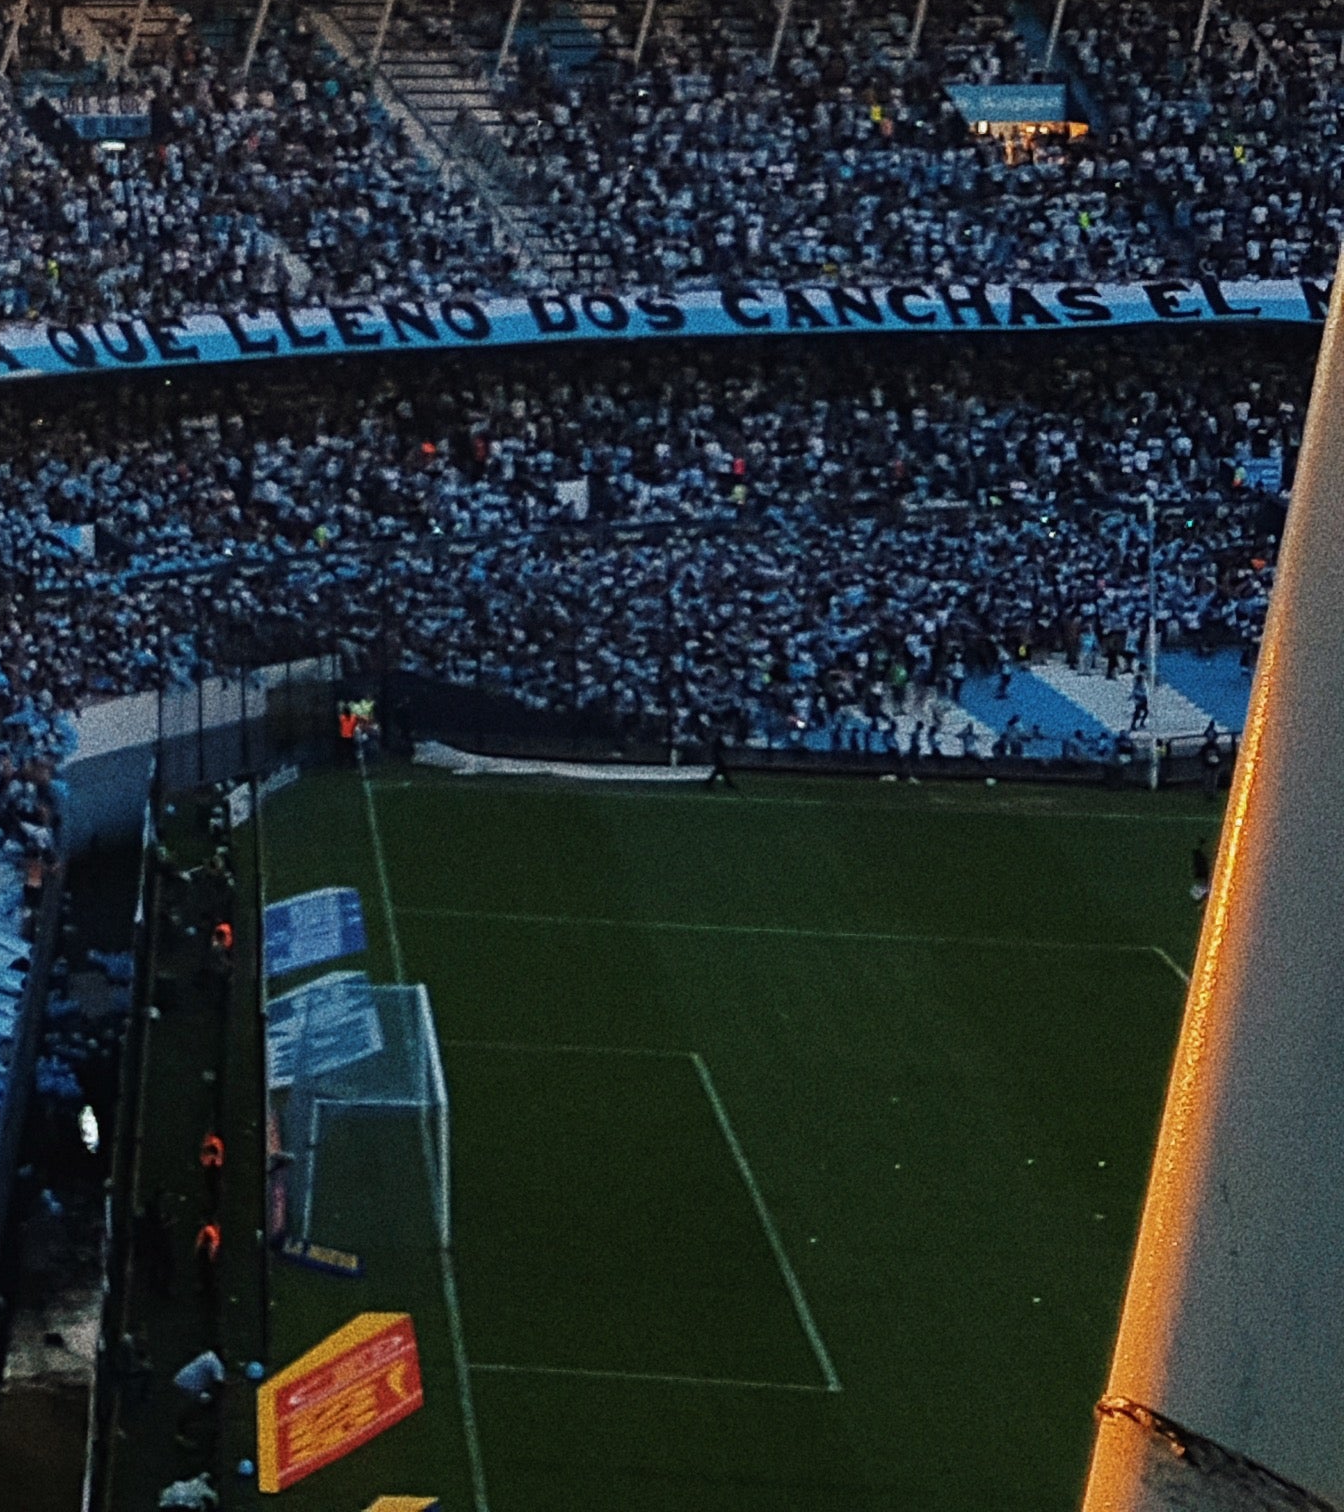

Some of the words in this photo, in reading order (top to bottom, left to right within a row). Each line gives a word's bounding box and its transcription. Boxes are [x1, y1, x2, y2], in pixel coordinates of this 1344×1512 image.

[47, 315, 200, 368] QUE
[528, 293, 685, 334] DOS
[720, 284, 1112, 328] CANCHAS
[1142, 280, 1261, 319] EL
